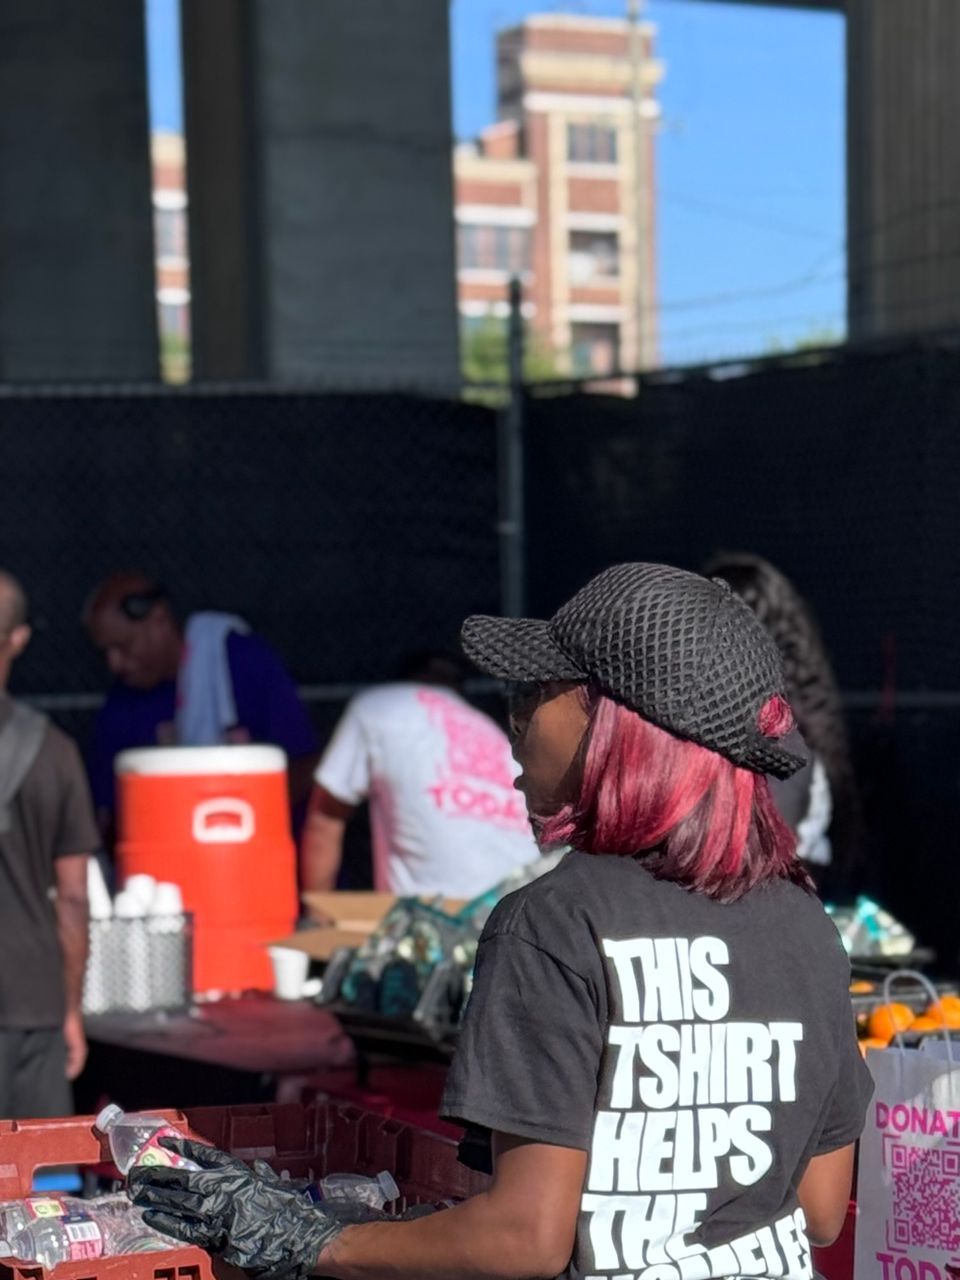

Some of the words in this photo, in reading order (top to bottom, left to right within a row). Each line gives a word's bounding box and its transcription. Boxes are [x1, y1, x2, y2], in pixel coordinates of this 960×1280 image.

[602, 935, 731, 1023] THIS
[607, 1021, 804, 1110] TSHIRT
[586, 1104, 773, 1192] HELPS
[580, 1192, 709, 1271] THE
